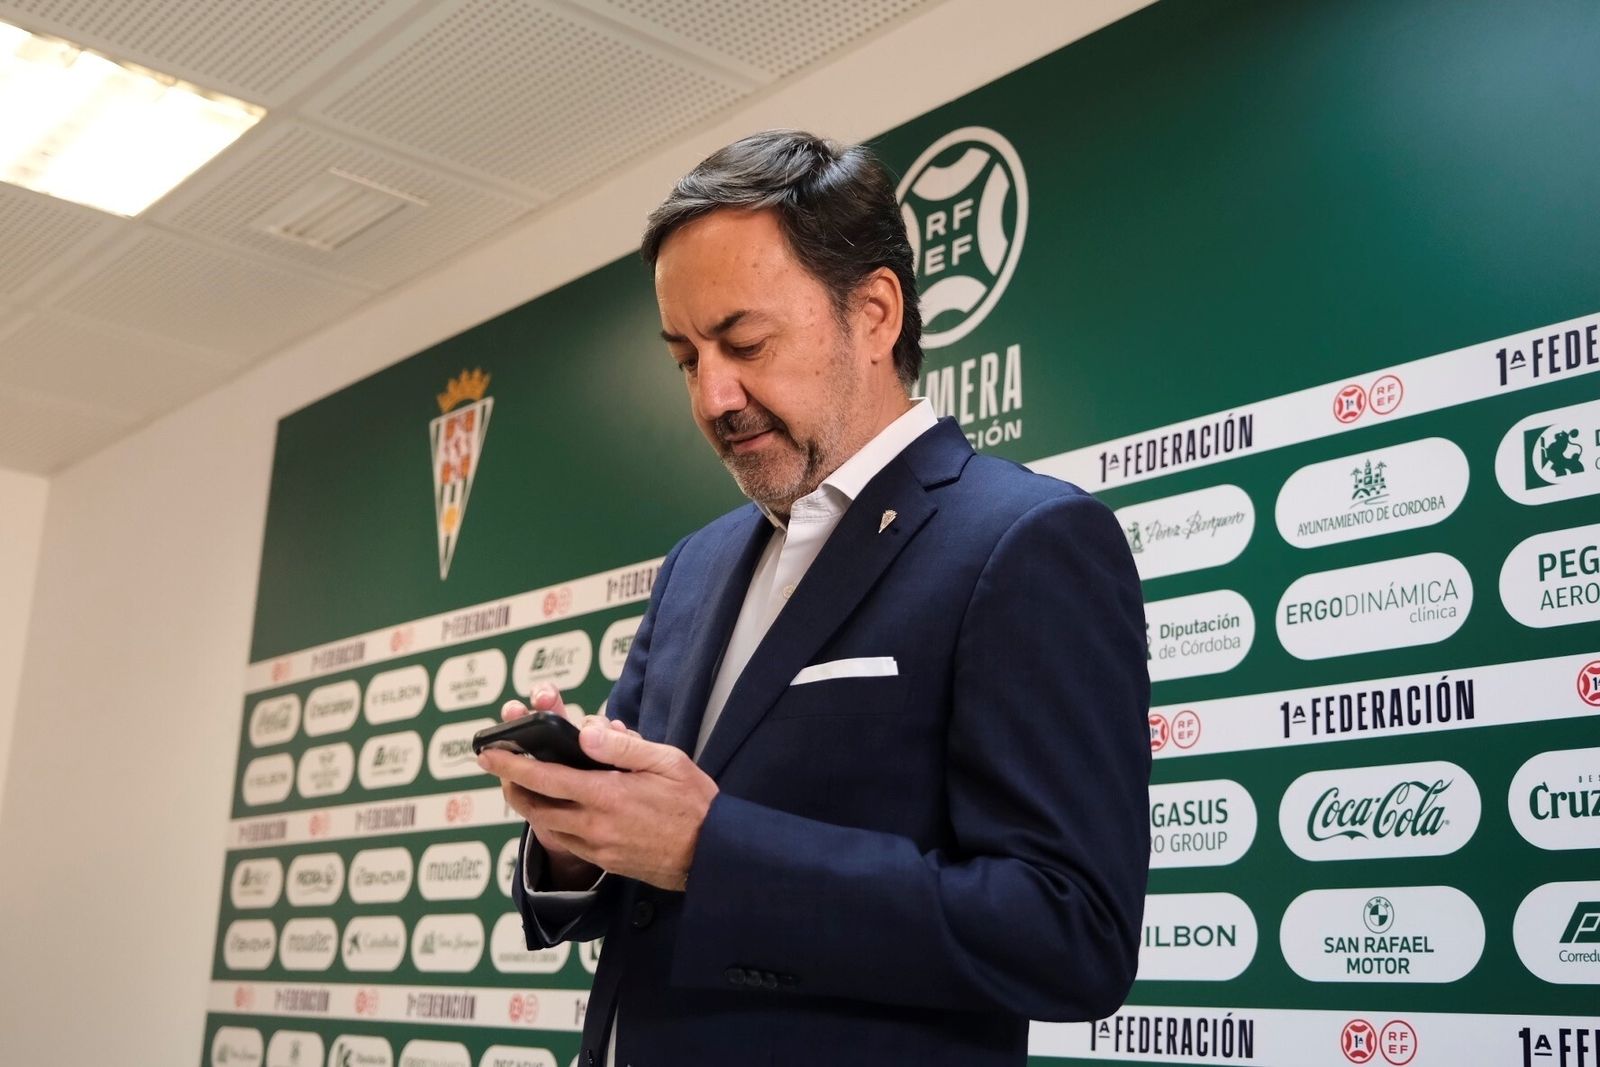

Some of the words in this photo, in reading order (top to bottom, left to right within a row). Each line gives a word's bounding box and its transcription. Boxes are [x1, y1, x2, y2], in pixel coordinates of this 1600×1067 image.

[911, 343, 1022, 426] MERA
[1123, 413, 1254, 478] FEDERACIÓN
[1297, 509, 1374, 537] AYUNTAMIENTO
[1376, 506, 1389, 521] DE
[1286, 578, 1459, 626] ERGODINÁMICA
[1409, 605, 1458, 624] clínica
[1160, 613, 1240, 640] Diputación
[1159, 644, 1177, 660] de
[1181, 635, 1241, 656] Córdoba
[1312, 675, 1475, 735] FEDERACIÓN
[1152, 798, 1229, 828] GASUS
[1170, 831, 1228, 853] GROUP
[1145, 924, 1236, 947] ILBON
[1324, 936, 1359, 953] SAN
[1364, 936, 1434, 953] RAFAEL
[1347, 957, 1410, 974] MOTOR
[1115, 1012, 1254, 1059] FEDERACIÓN
